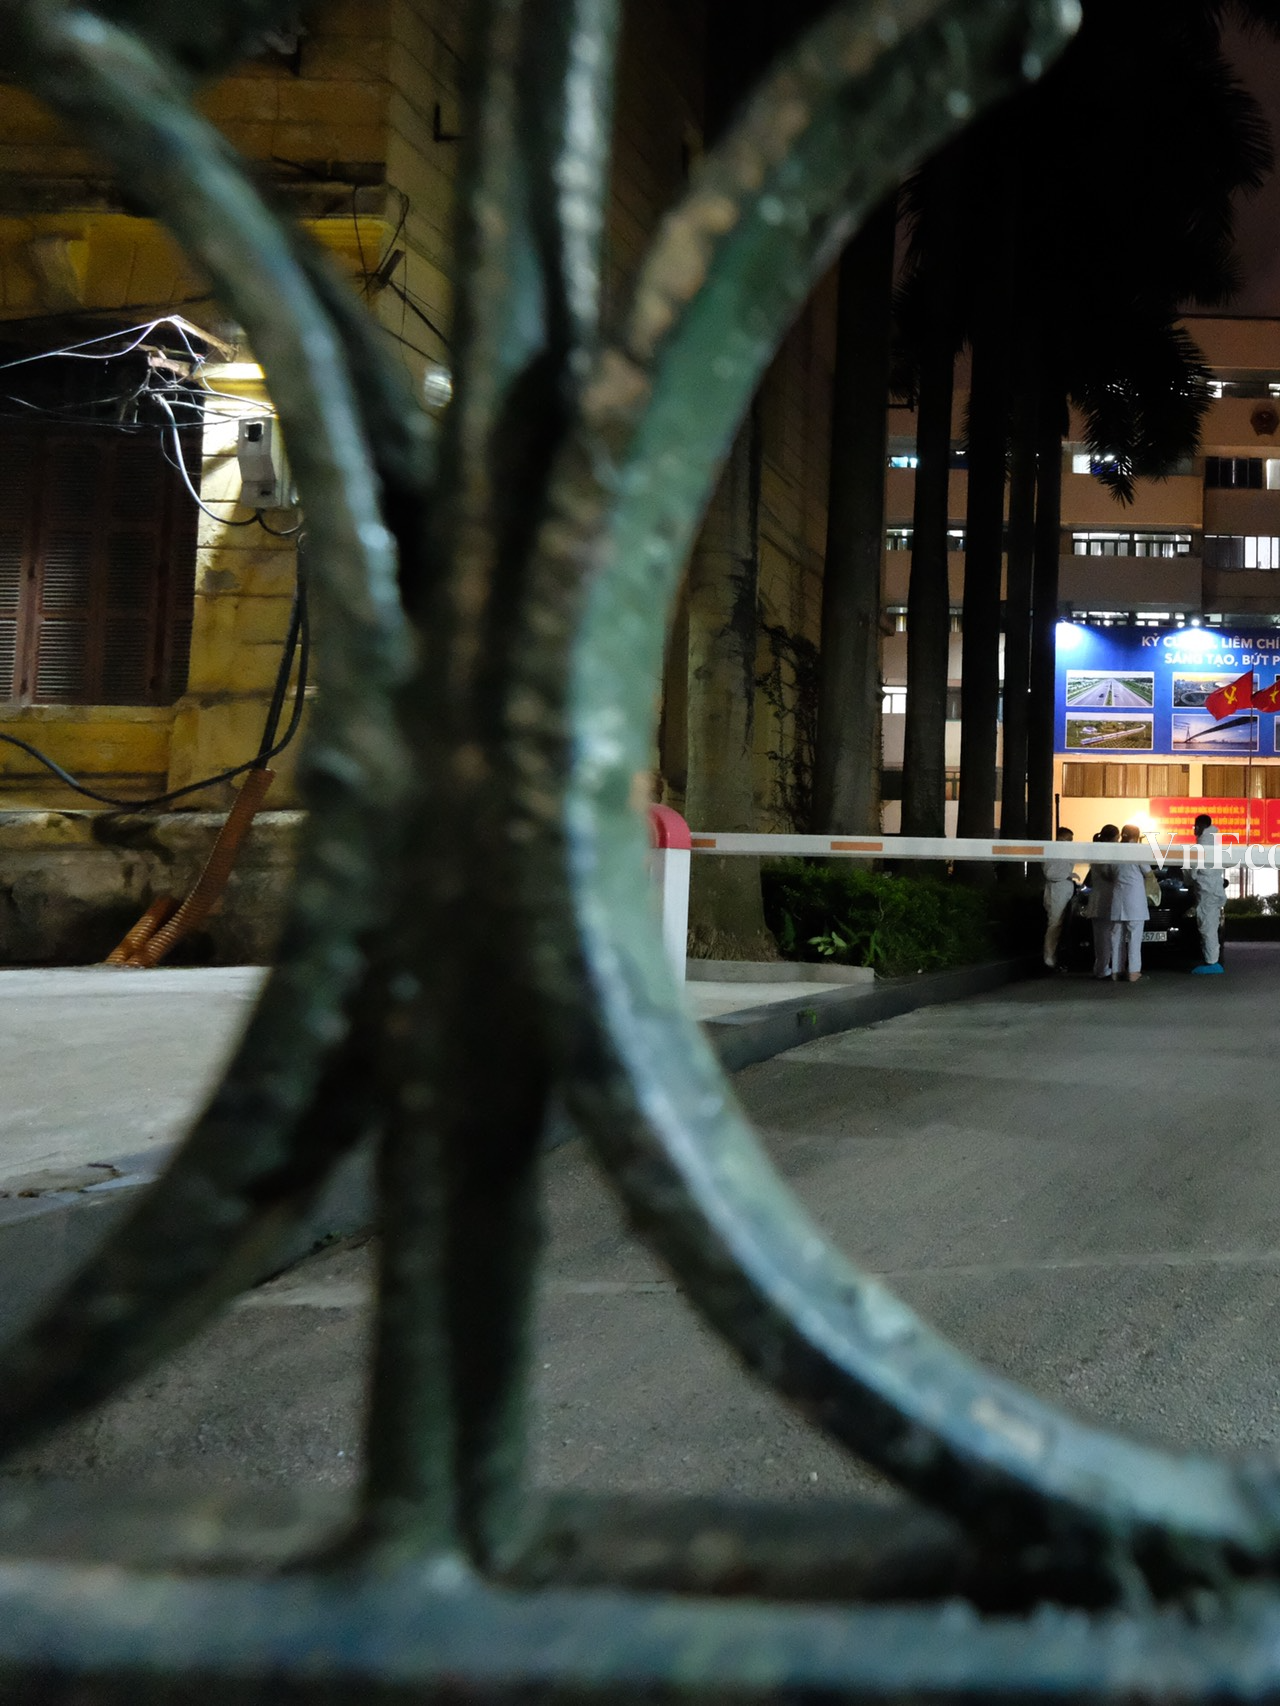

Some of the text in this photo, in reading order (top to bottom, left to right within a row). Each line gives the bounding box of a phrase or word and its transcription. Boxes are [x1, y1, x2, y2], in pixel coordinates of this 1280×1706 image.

[1142, 633, 1160, 647] KỶ
[1221, 635, 1253, 649] LIÊM
[1207, 653, 1239, 668] TẠO,
[1242, 652, 1269, 666] BỨT
